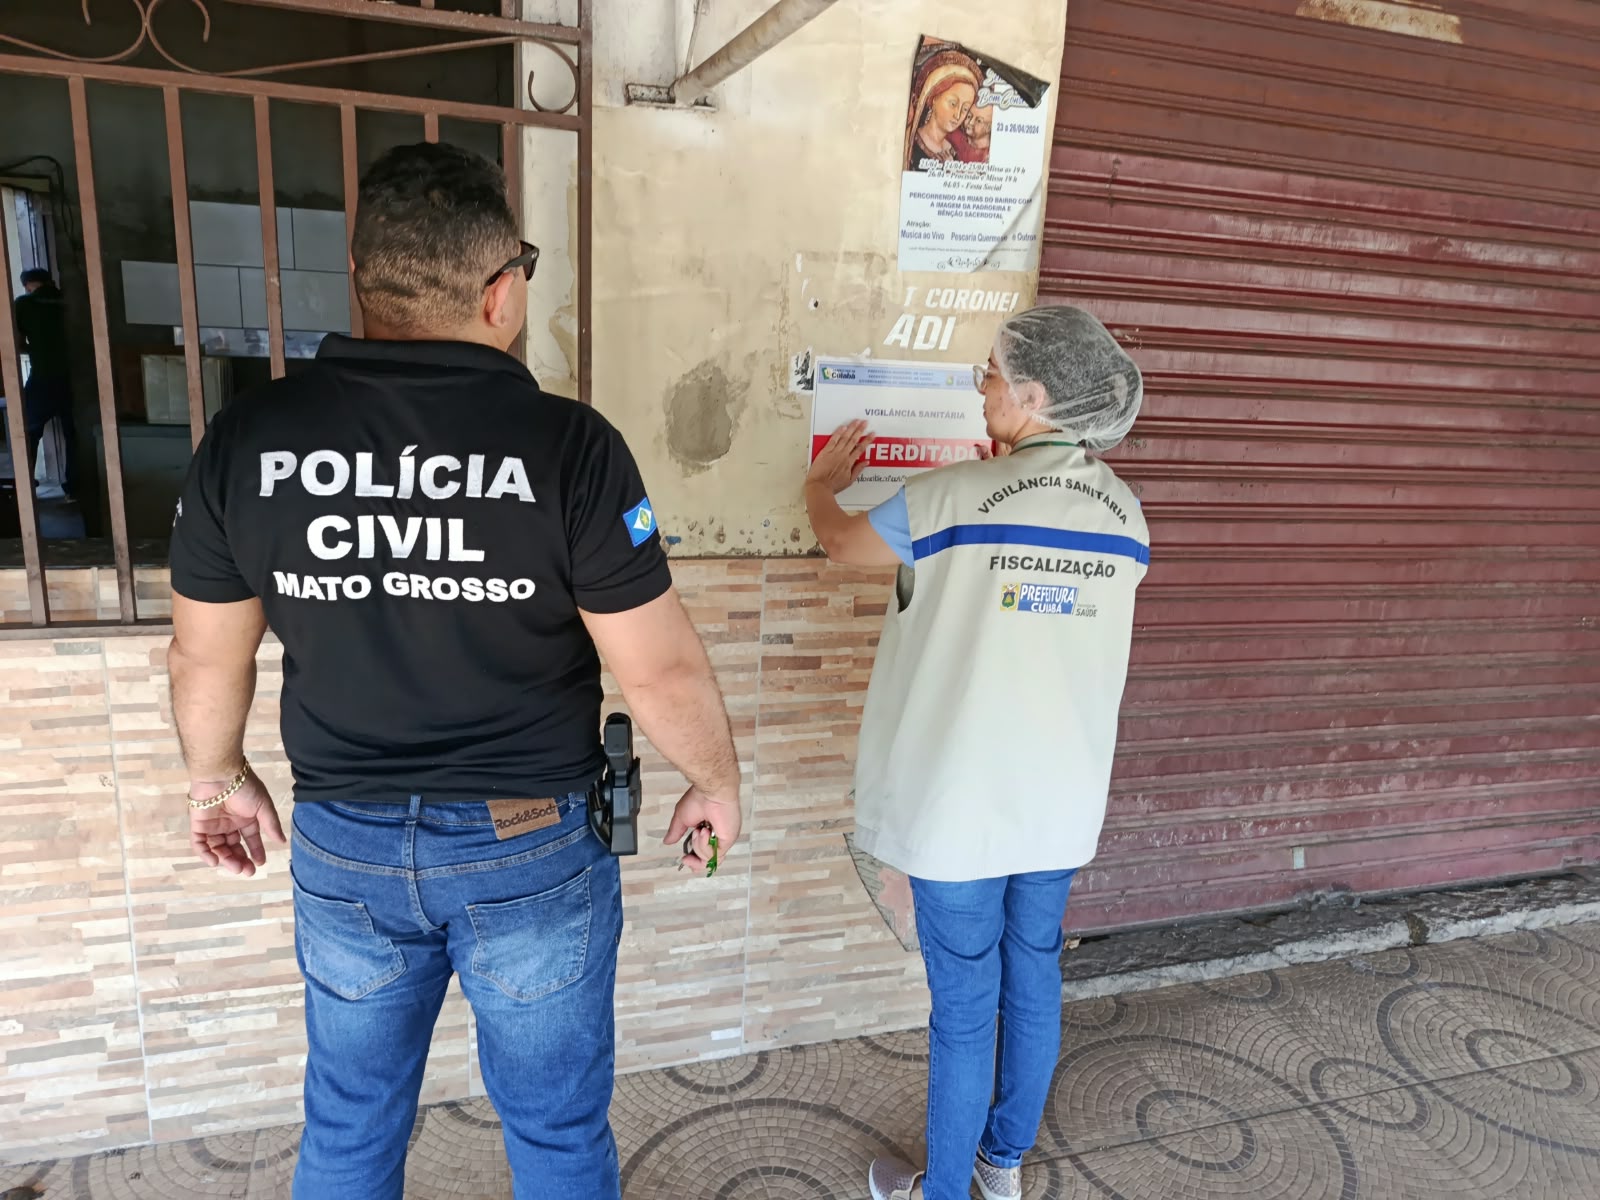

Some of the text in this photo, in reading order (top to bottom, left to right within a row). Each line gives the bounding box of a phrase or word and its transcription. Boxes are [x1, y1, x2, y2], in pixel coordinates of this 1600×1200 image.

[997, 122, 1003, 131] 23
[1009, 123, 1039, 134] 26/04/2024
[909, 191, 956, 201] PERCORRENDO
[994, 196, 1017, 204] BAIRRO
[972, 204, 1006, 212] PADROEIRA
[923, 232, 931, 240] ao
[931, 231, 945, 240] Vivo
[951, 231, 977, 241] Pescaria
[865, 407, 966, 419] VIGILÂNCIA SANITÁRIA
[259, 444, 537, 502] POLÍCIA
[977, 475, 1127, 525] VIGILÂNCIA SANITÁRIA
[306, 514, 485, 562] CIVIL
[989, 555, 1116, 580] FISCALIZAÇÃO
[273, 571, 536, 602] MATO GROSSO
[1020, 583, 1076, 604] PREFEITURA
[1075, 606, 1098, 618] SAÚDE
